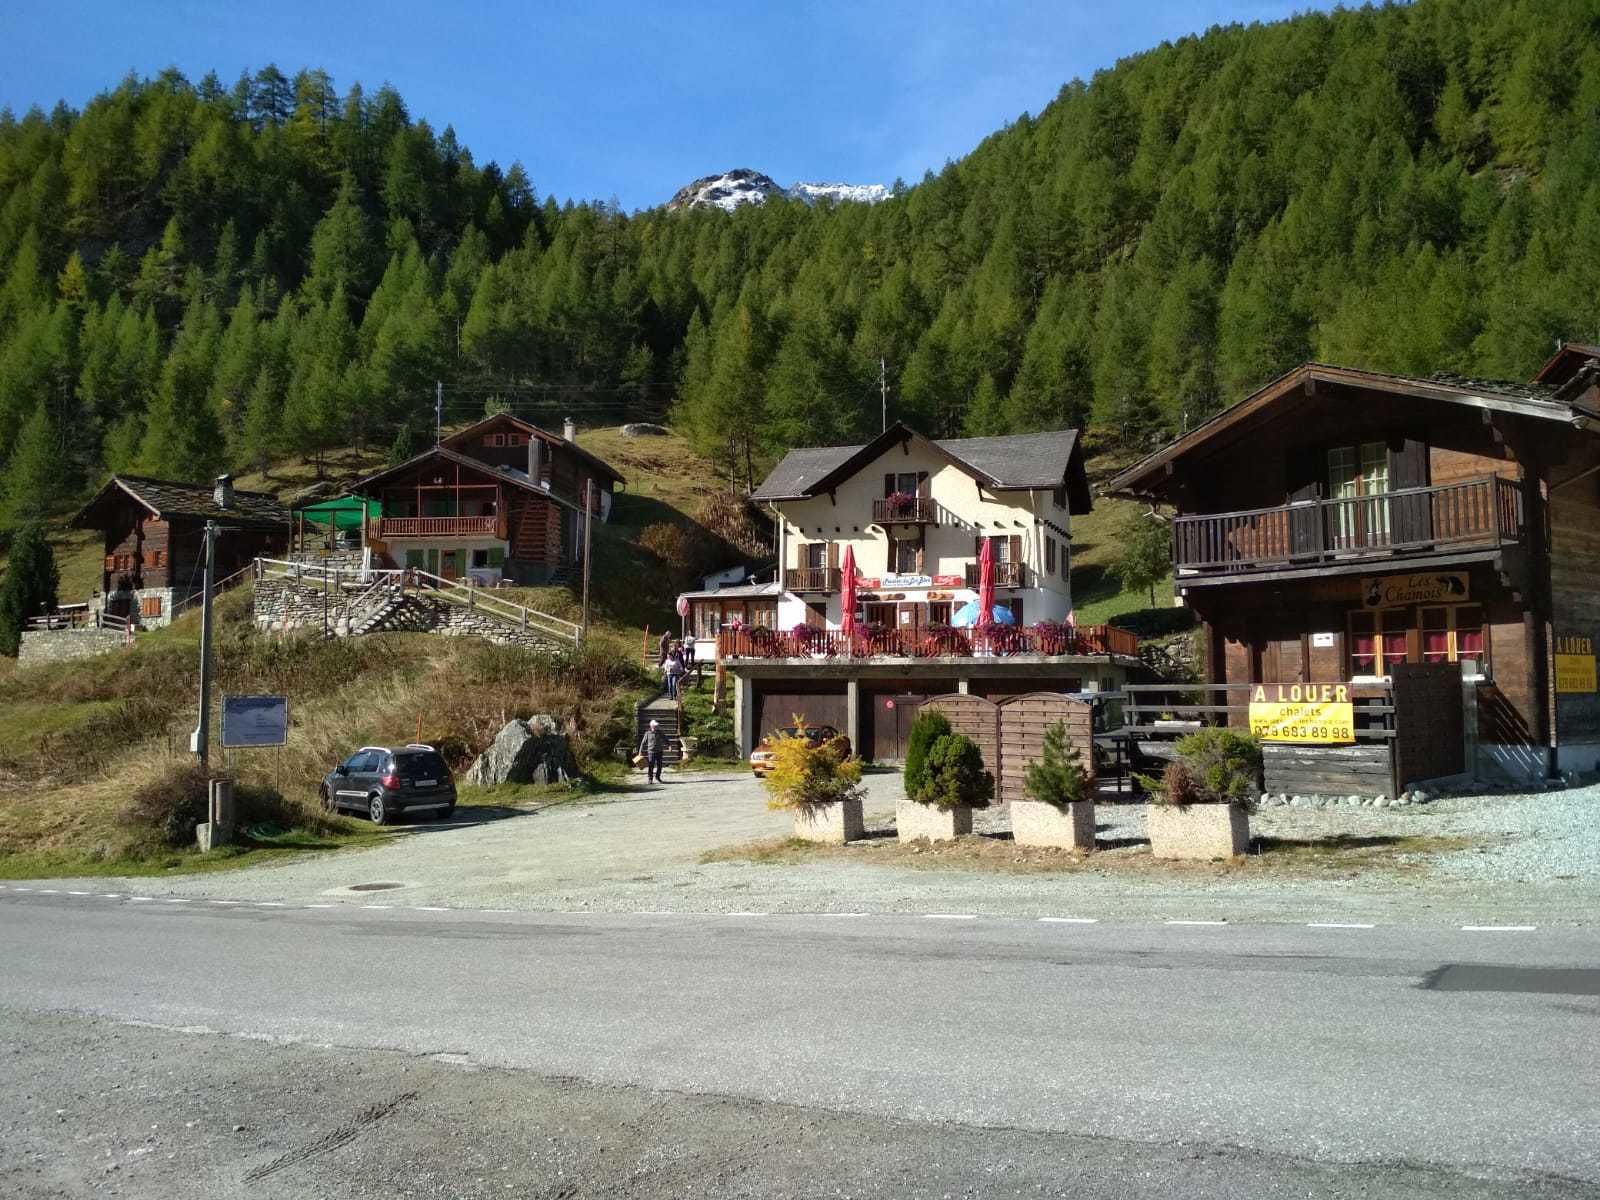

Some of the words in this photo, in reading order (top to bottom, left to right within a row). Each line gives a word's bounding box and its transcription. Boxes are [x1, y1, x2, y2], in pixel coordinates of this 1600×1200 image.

[1408, 575, 1431, 588] Les
[1385, 586, 1441, 602] Chamois
[1254, 685, 1266, 702] A
[1278, 685, 1348, 702] LOUER
[1279, 706, 1322, 717] chalets
[1282, 726, 1307, 738] 683
[1312, 727, 1328, 738] 89
[1333, 727, 1350, 739] 98
